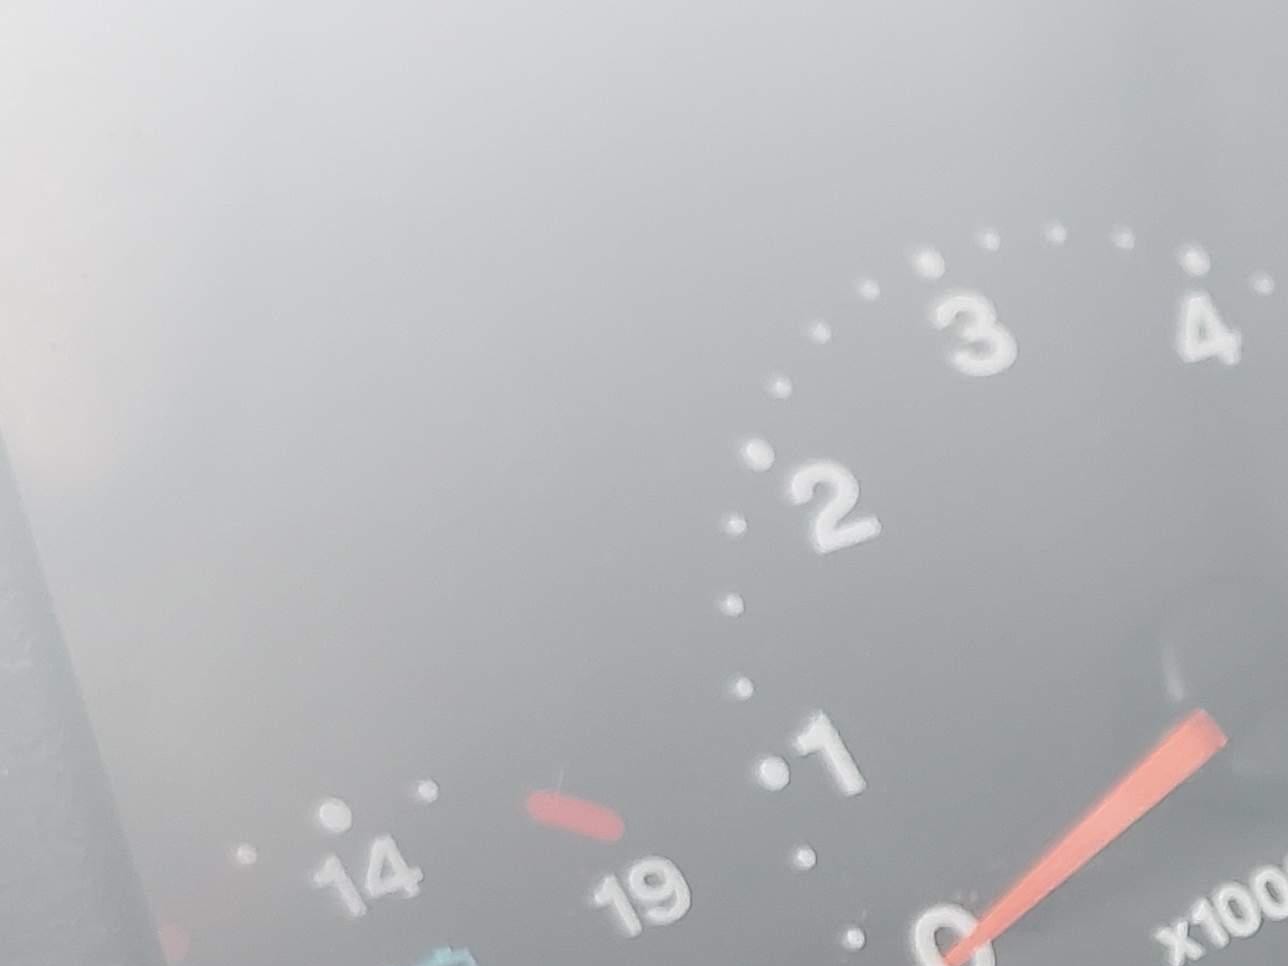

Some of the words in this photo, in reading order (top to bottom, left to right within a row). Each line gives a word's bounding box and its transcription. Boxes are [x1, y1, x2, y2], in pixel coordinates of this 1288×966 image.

[932, 292, 1017, 376] 3
[1176, 291, 1242, 365] 4
[789, 460, 882, 553] 2
[793, 709, 866, 796] 1
[309, 834, 425, 918] 14
[593, 855, 692, 937] 19
